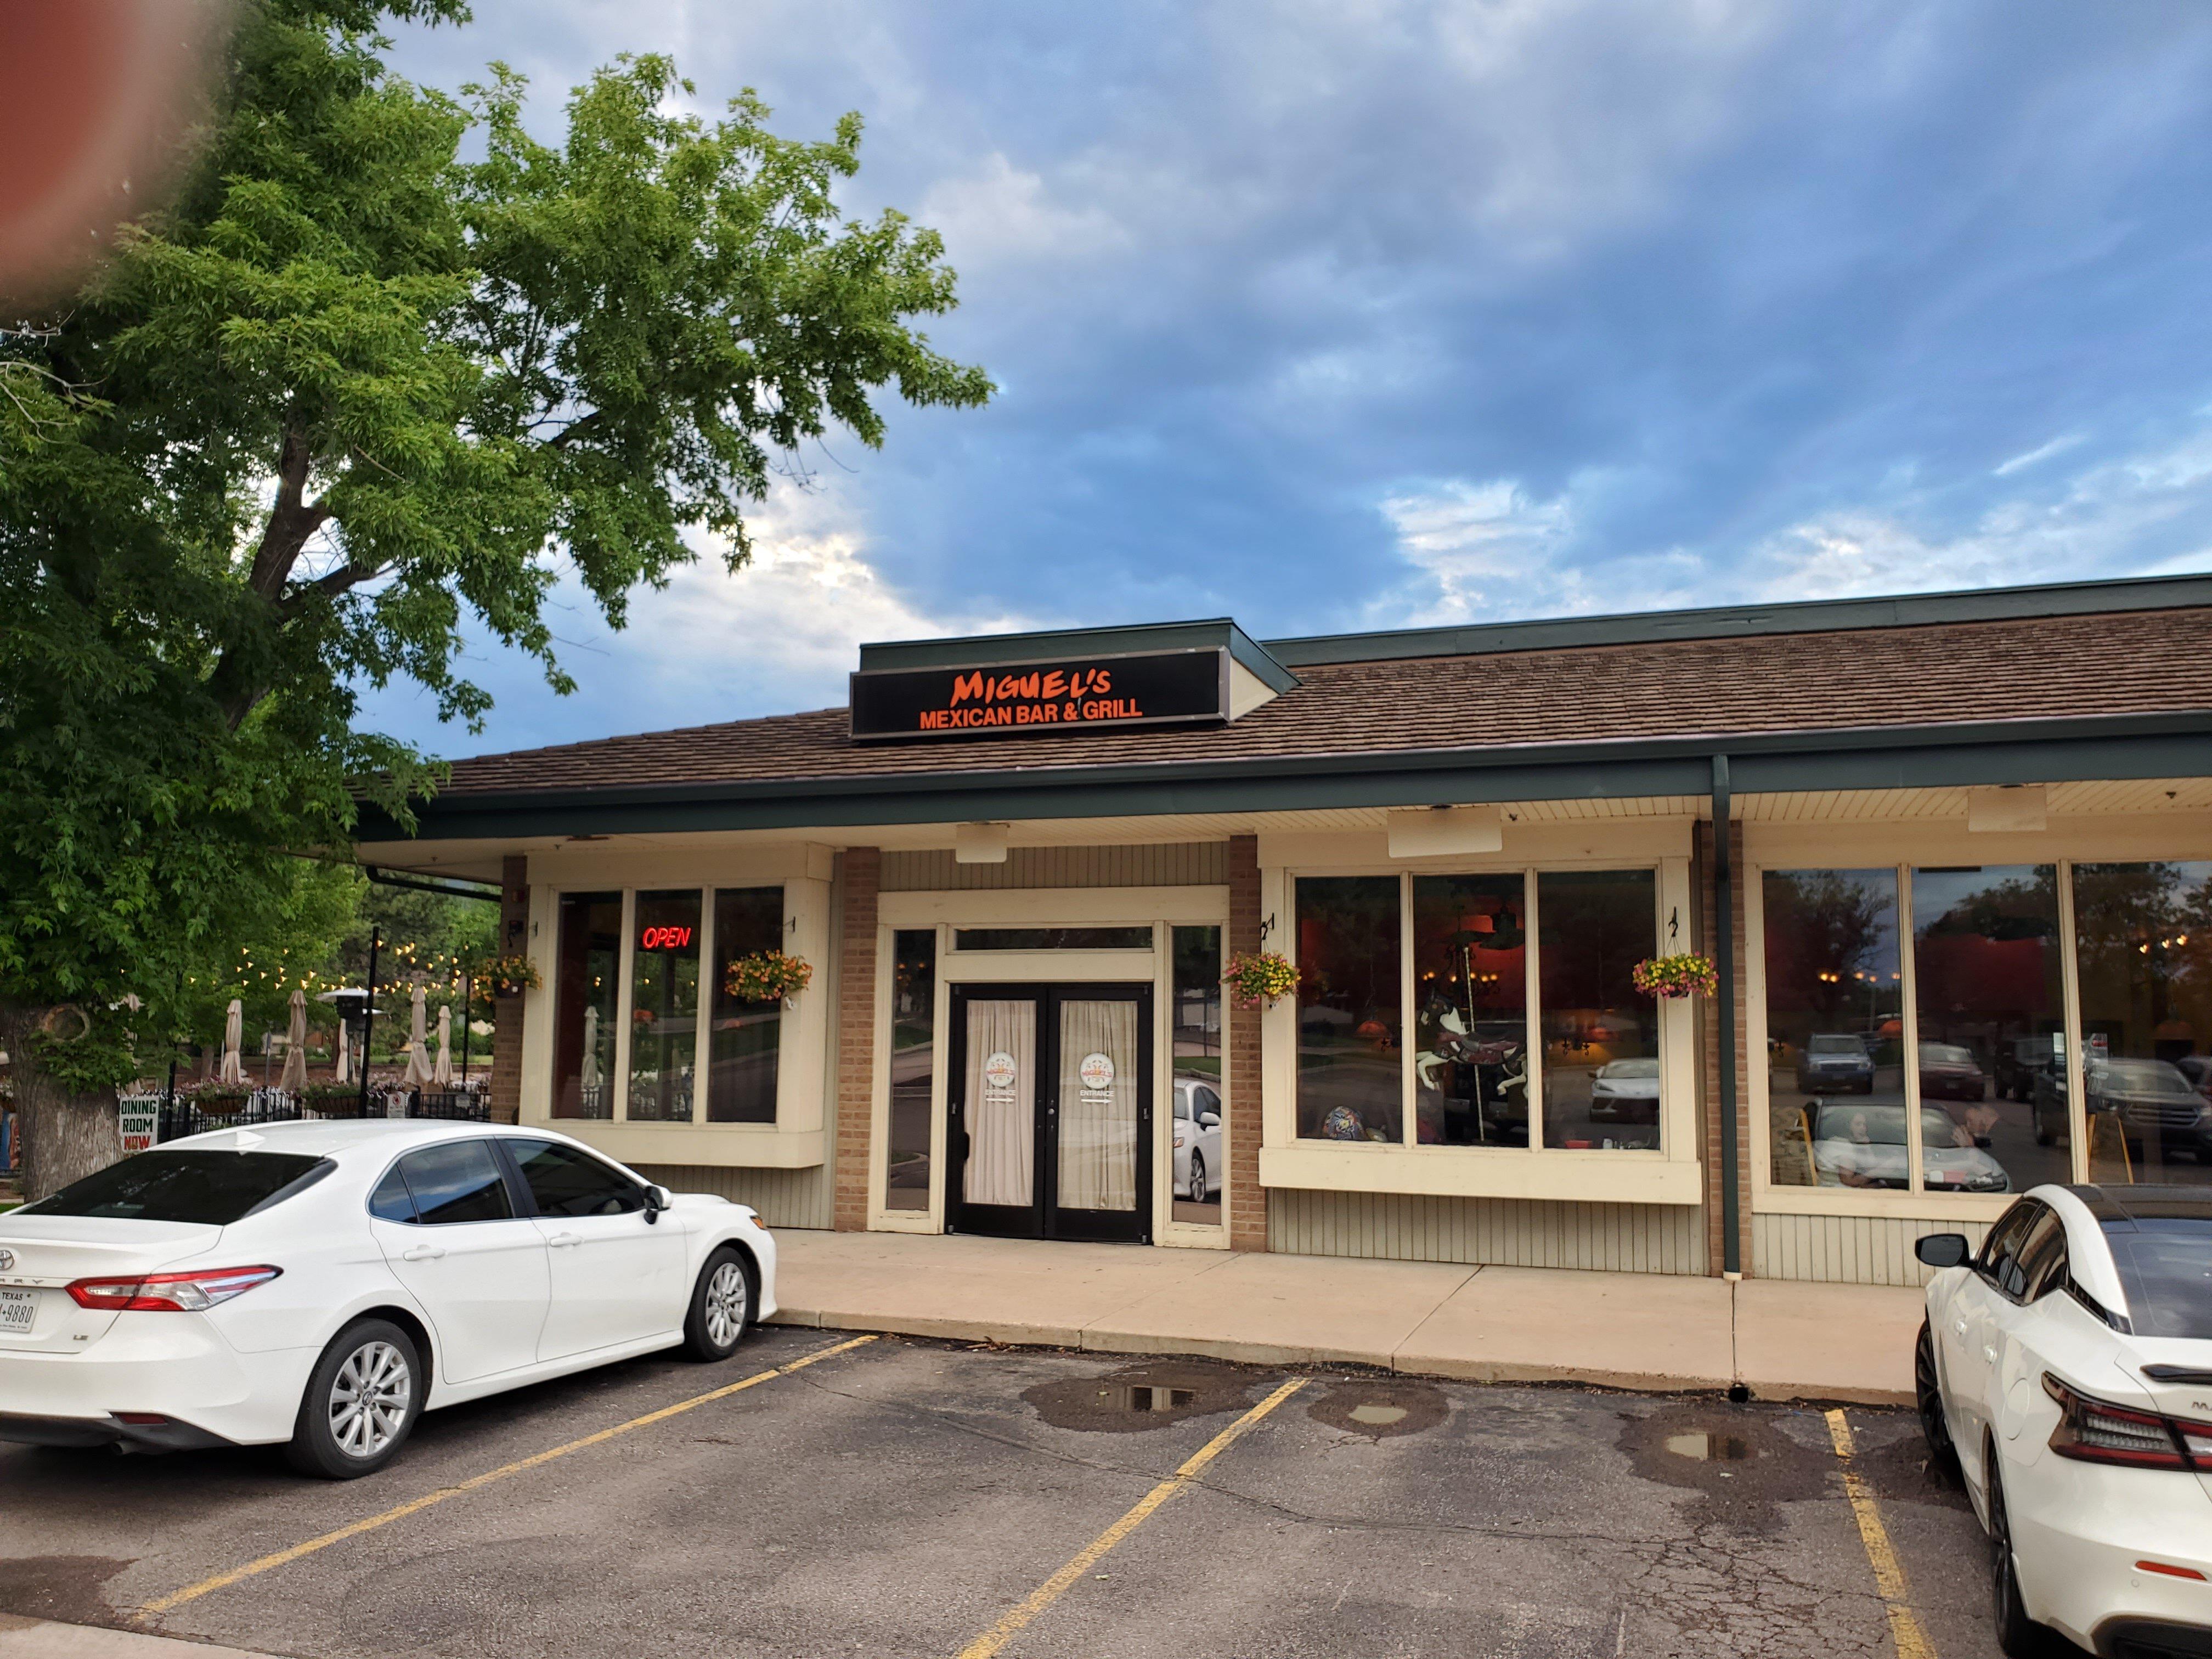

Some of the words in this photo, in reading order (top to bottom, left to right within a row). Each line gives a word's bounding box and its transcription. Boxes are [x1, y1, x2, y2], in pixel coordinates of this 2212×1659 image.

[950, 668, 1111, 708] MIGUEL'S
[920, 706, 1011, 730] MEXICAN
[1016, 702, 1058, 724] BAR
[1063, 702, 1079, 721] &
[1082, 698, 1143, 719] GRILL
[642, 927, 691, 949] OPEN
[1079, 1089, 1115, 1097] ENTRANCE
[121, 1099, 157, 1115] DINING
[122, 1118, 153, 1133] ROOM
[123, 1135, 151, 1150] NOW
[2, 1292, 23, 1301] TEXAS
[0, 1304, 33, 1323] 9880
